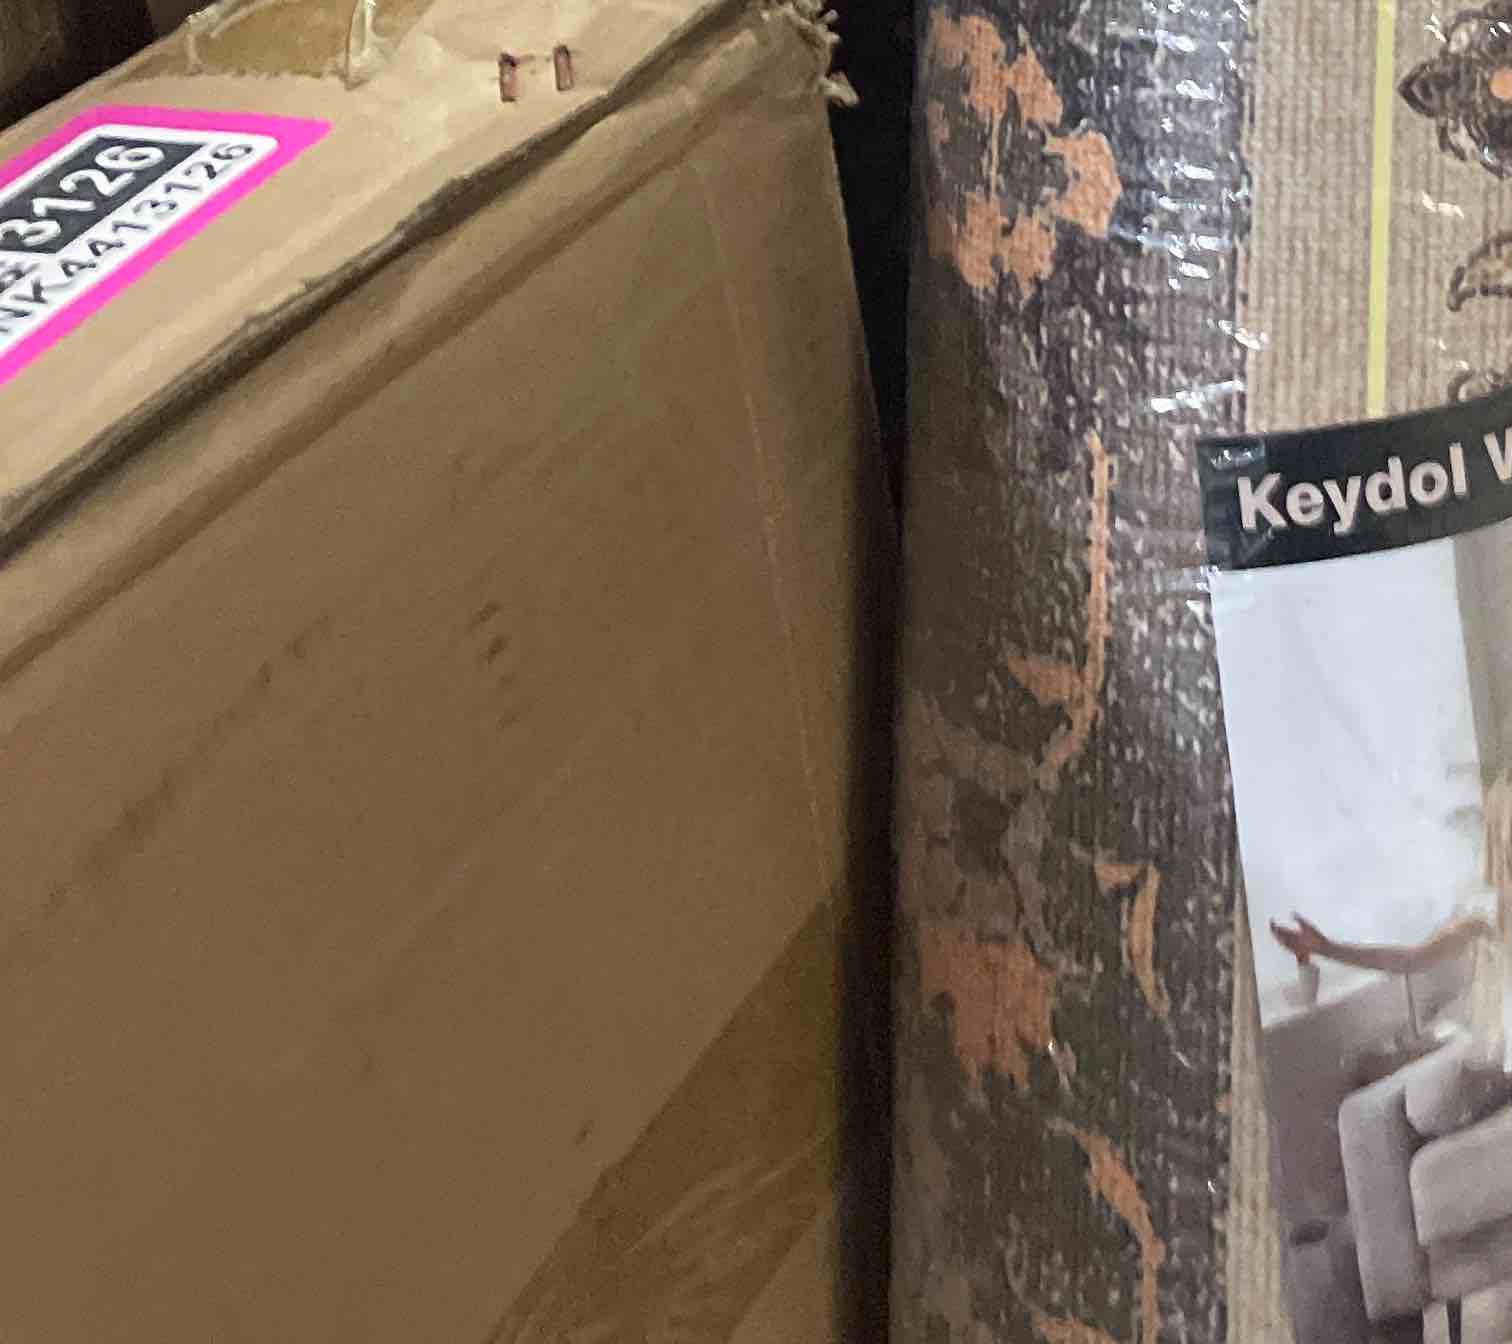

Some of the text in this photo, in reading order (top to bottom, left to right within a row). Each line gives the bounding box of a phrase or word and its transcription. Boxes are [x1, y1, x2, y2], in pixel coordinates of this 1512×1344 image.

[0, 145, 166, 247] 3126
[0, 142, 254, 334] NK4413126
[1236, 441, 1469, 537] Keydol
